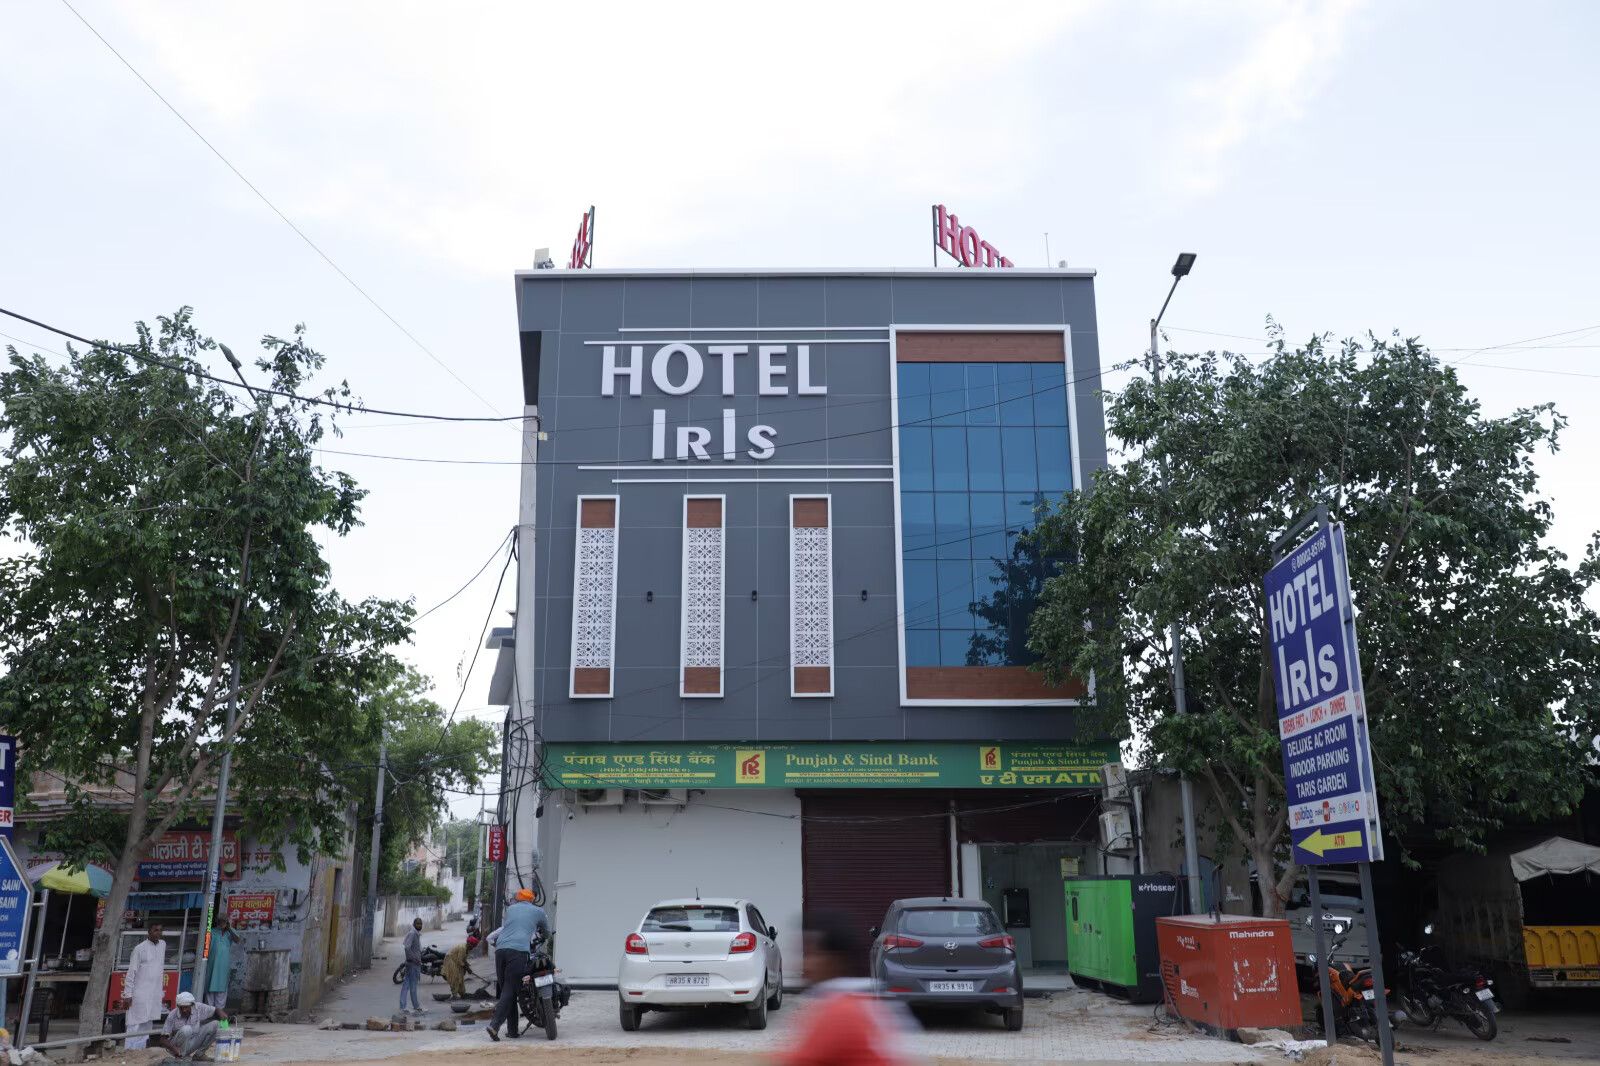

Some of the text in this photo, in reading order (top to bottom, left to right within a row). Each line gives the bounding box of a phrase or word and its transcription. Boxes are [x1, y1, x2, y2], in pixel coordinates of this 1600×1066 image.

[601, 342, 828, 397] HOTEL
[652, 408, 777, 461] IRIS
[1269, 558, 1335, 643] HOTEL
[1277, 628, 1339, 710] IRIS
[1287, 722, 1348, 758] DELUXE AC ROOM
[563, 752, 607, 765] पंजाब
[612, 755, 645, 767] एण्ड
[686, 751, 716, 765] बैंक
[785, 753, 939, 768] Punjab & Sind Bank
[1011, 758, 1045, 766] Punjab
[1290, 746, 1350, 779] INDOOR PARKING
[980, 774, 993, 785] ए
[999, 771, 1018, 785] टी
[1022, 774, 1053, 785] एम
[1296, 771, 1348, 799] TARIS GARDEN
[493, 832, 502, 860] ENTRY
[1334, 834, 1346, 848] ATM
[2, 879, 22, 891] SAINI
[244, 897, 272, 908] बालाजी
